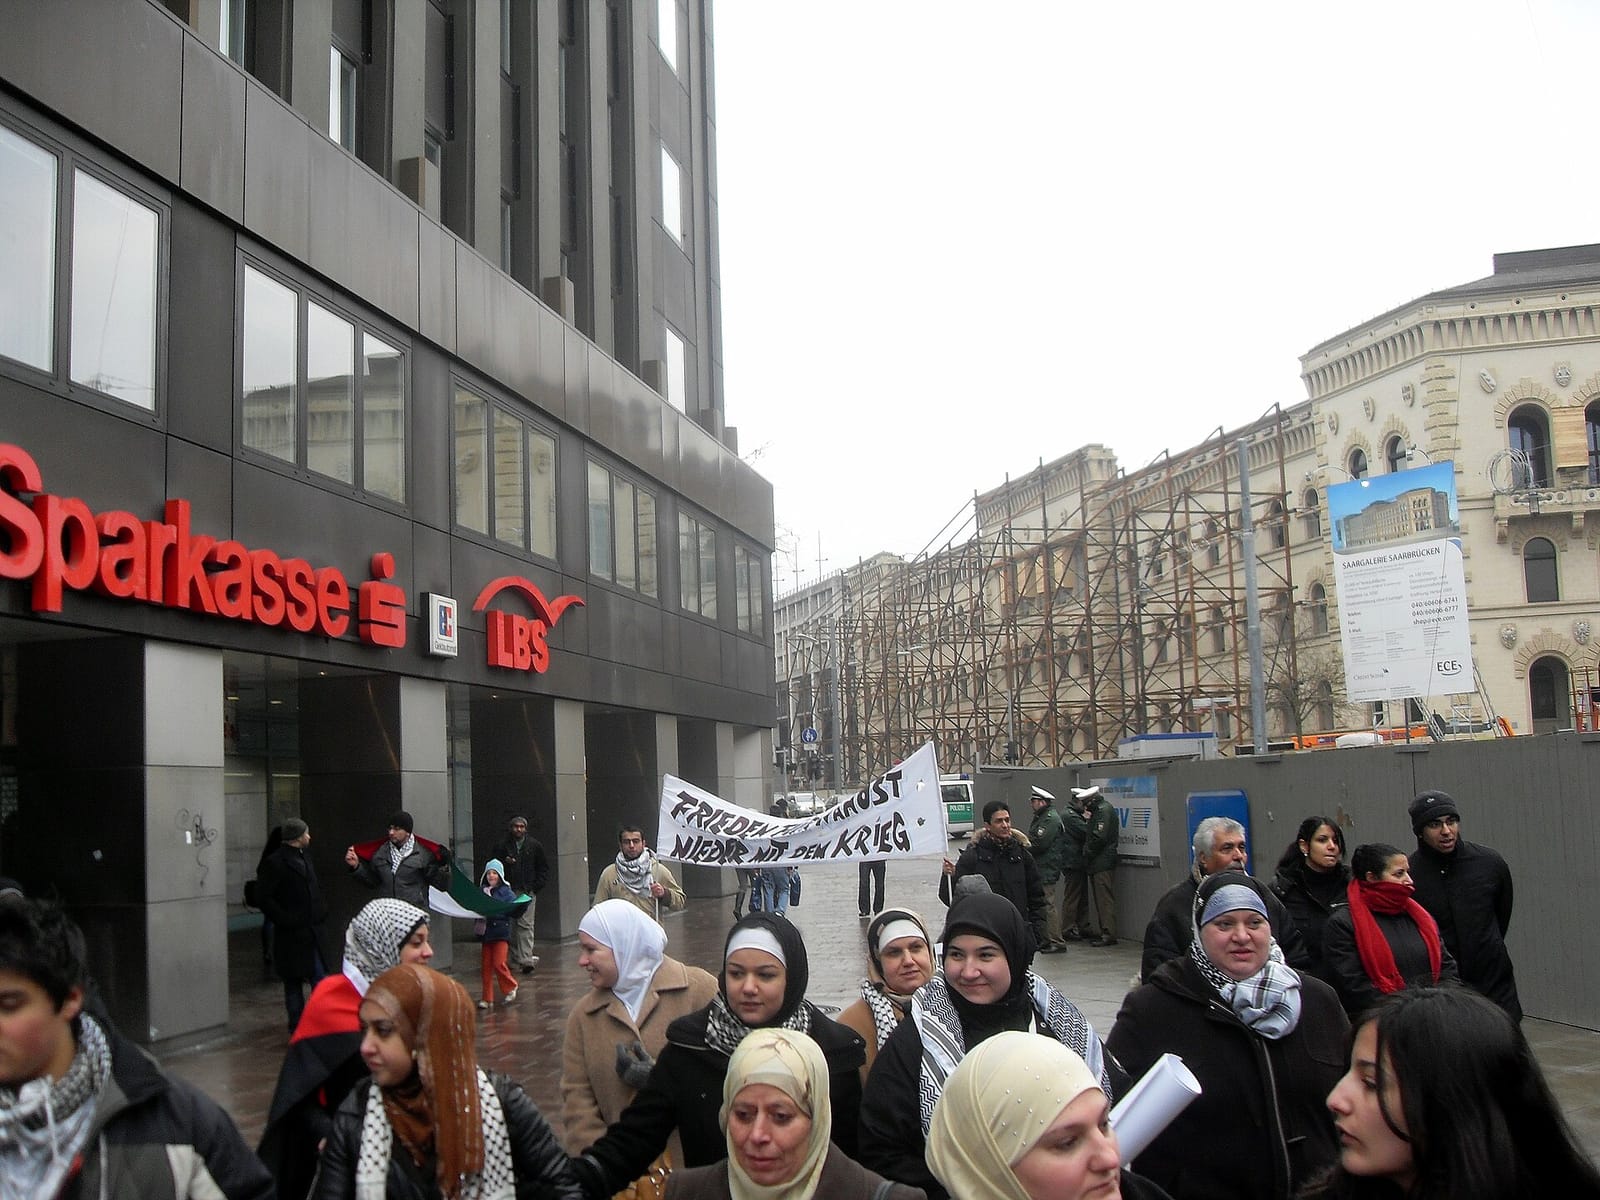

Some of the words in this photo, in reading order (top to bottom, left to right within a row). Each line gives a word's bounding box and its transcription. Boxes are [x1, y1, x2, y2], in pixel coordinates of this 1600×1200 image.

[0, 443, 351, 638] Sparkasse
[1343, 555, 1388, 569] SAARGALERIE
[1388, 546, 1441, 563] SAARBRÜCKEN
[487, 609, 551, 674] LBS
[1437, 660, 1458, 673] ECE
[670, 790, 779, 840] FRIEDEN
[748, 839, 789, 863] MIT
[788, 840, 831, 860] DEM
[830, 812, 911, 859] KRIEG
